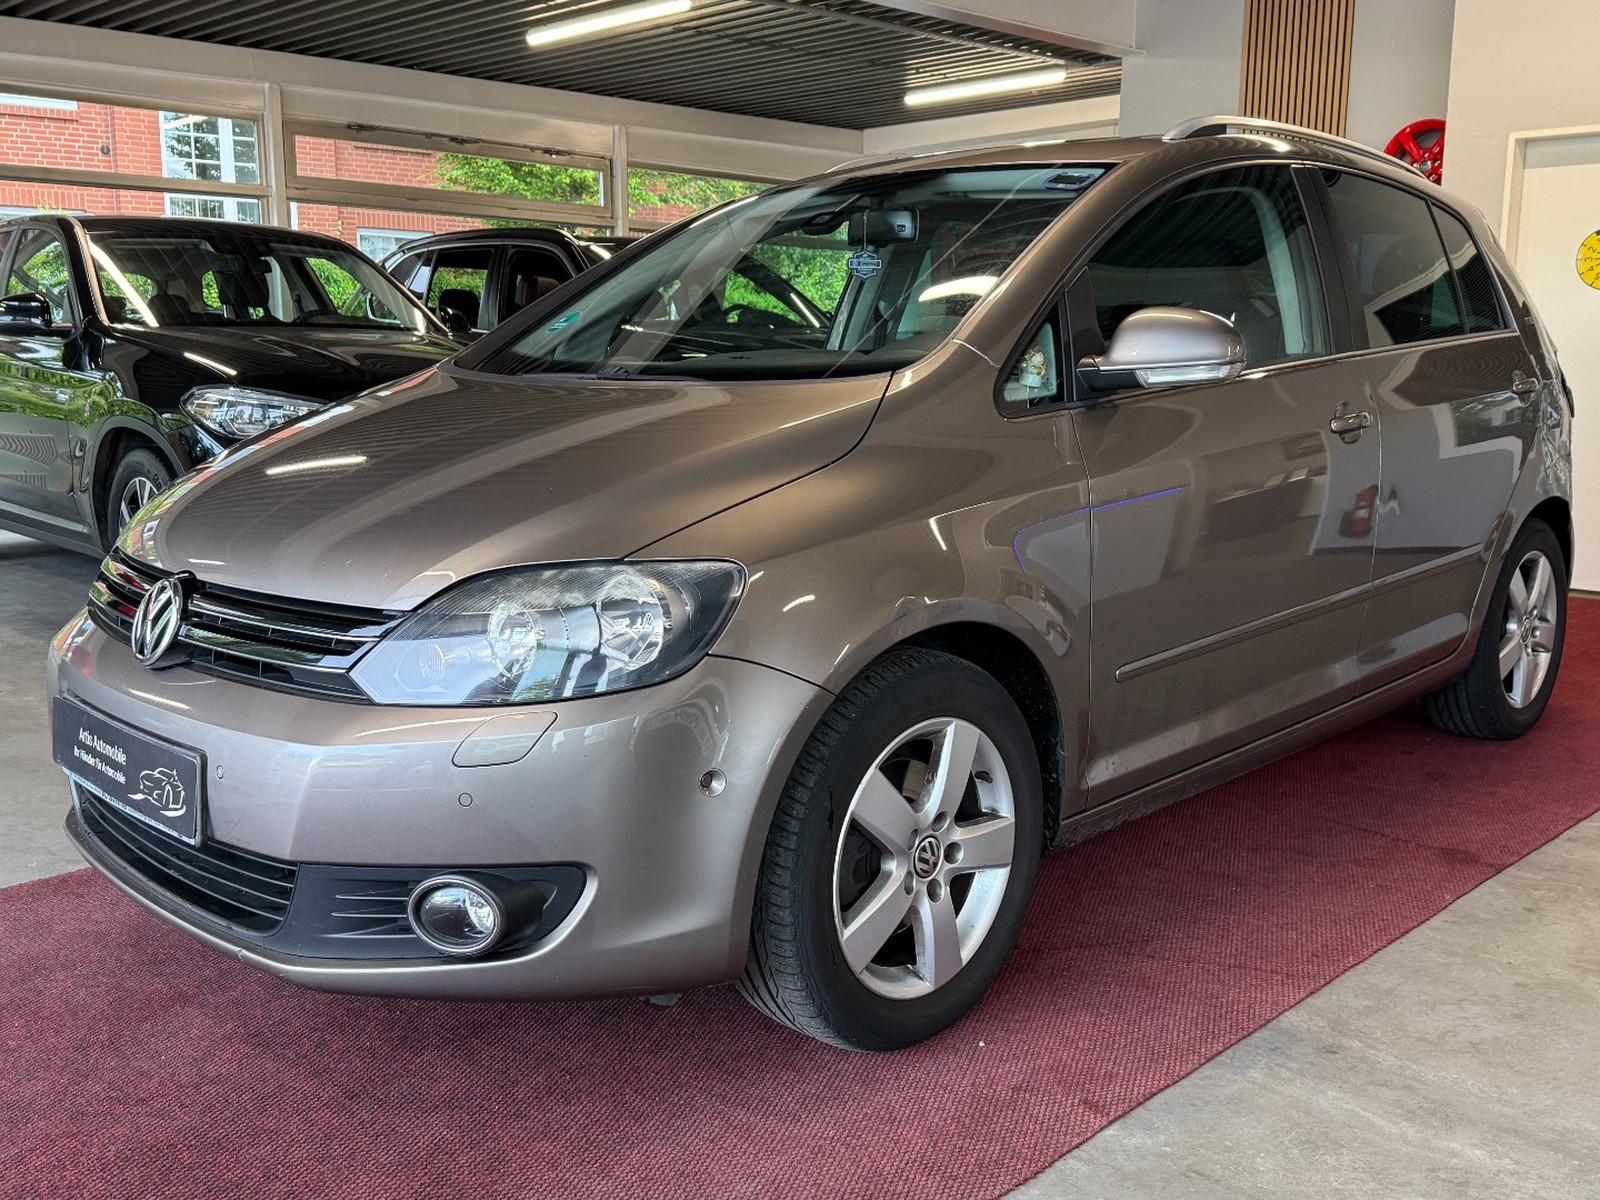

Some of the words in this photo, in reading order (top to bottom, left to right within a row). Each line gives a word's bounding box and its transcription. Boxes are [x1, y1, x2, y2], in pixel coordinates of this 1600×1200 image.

[78, 726, 93, 747] Artis
[93, 735, 127, 765] Automobile
[102, 761, 126, 785] Automobile
